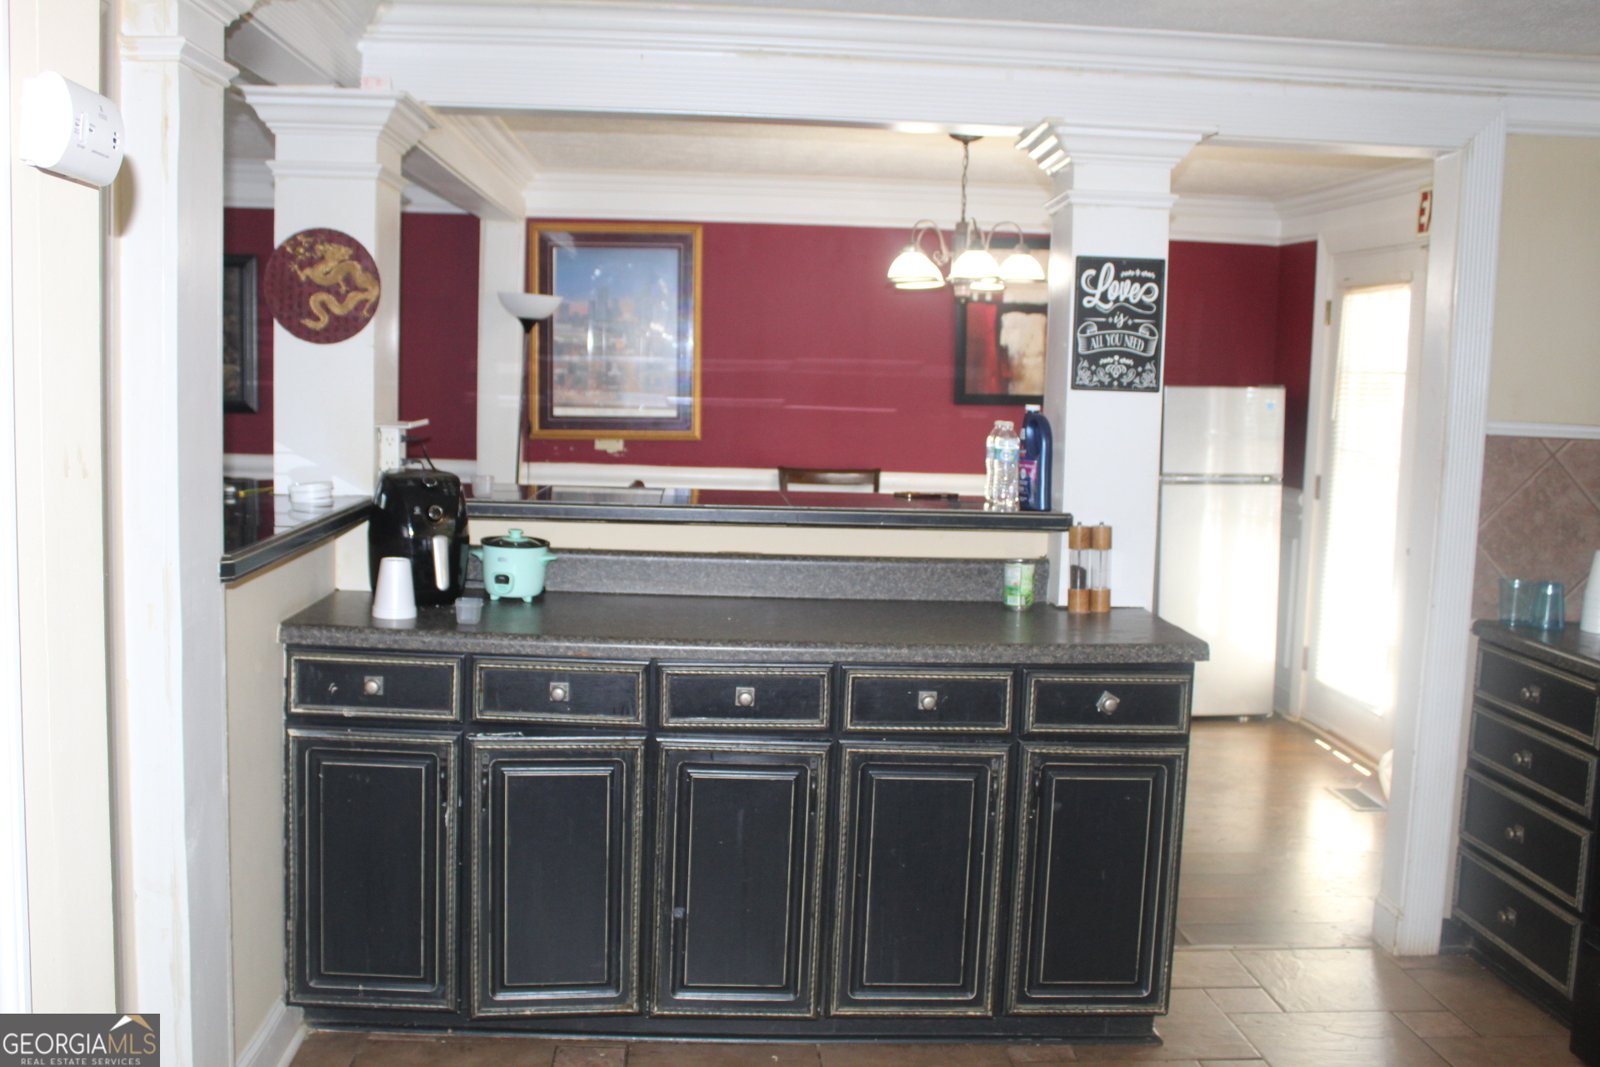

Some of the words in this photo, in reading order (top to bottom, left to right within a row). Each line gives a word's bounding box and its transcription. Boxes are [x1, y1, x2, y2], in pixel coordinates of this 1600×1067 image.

[1080, 262, 1159, 309] Love
[1113, 311, 1128, 328] is
[1090, 335, 1104, 350] ALL
[1105, 333, 1123, 347] YOU
[1123, 334, 1145, 352] NEED
